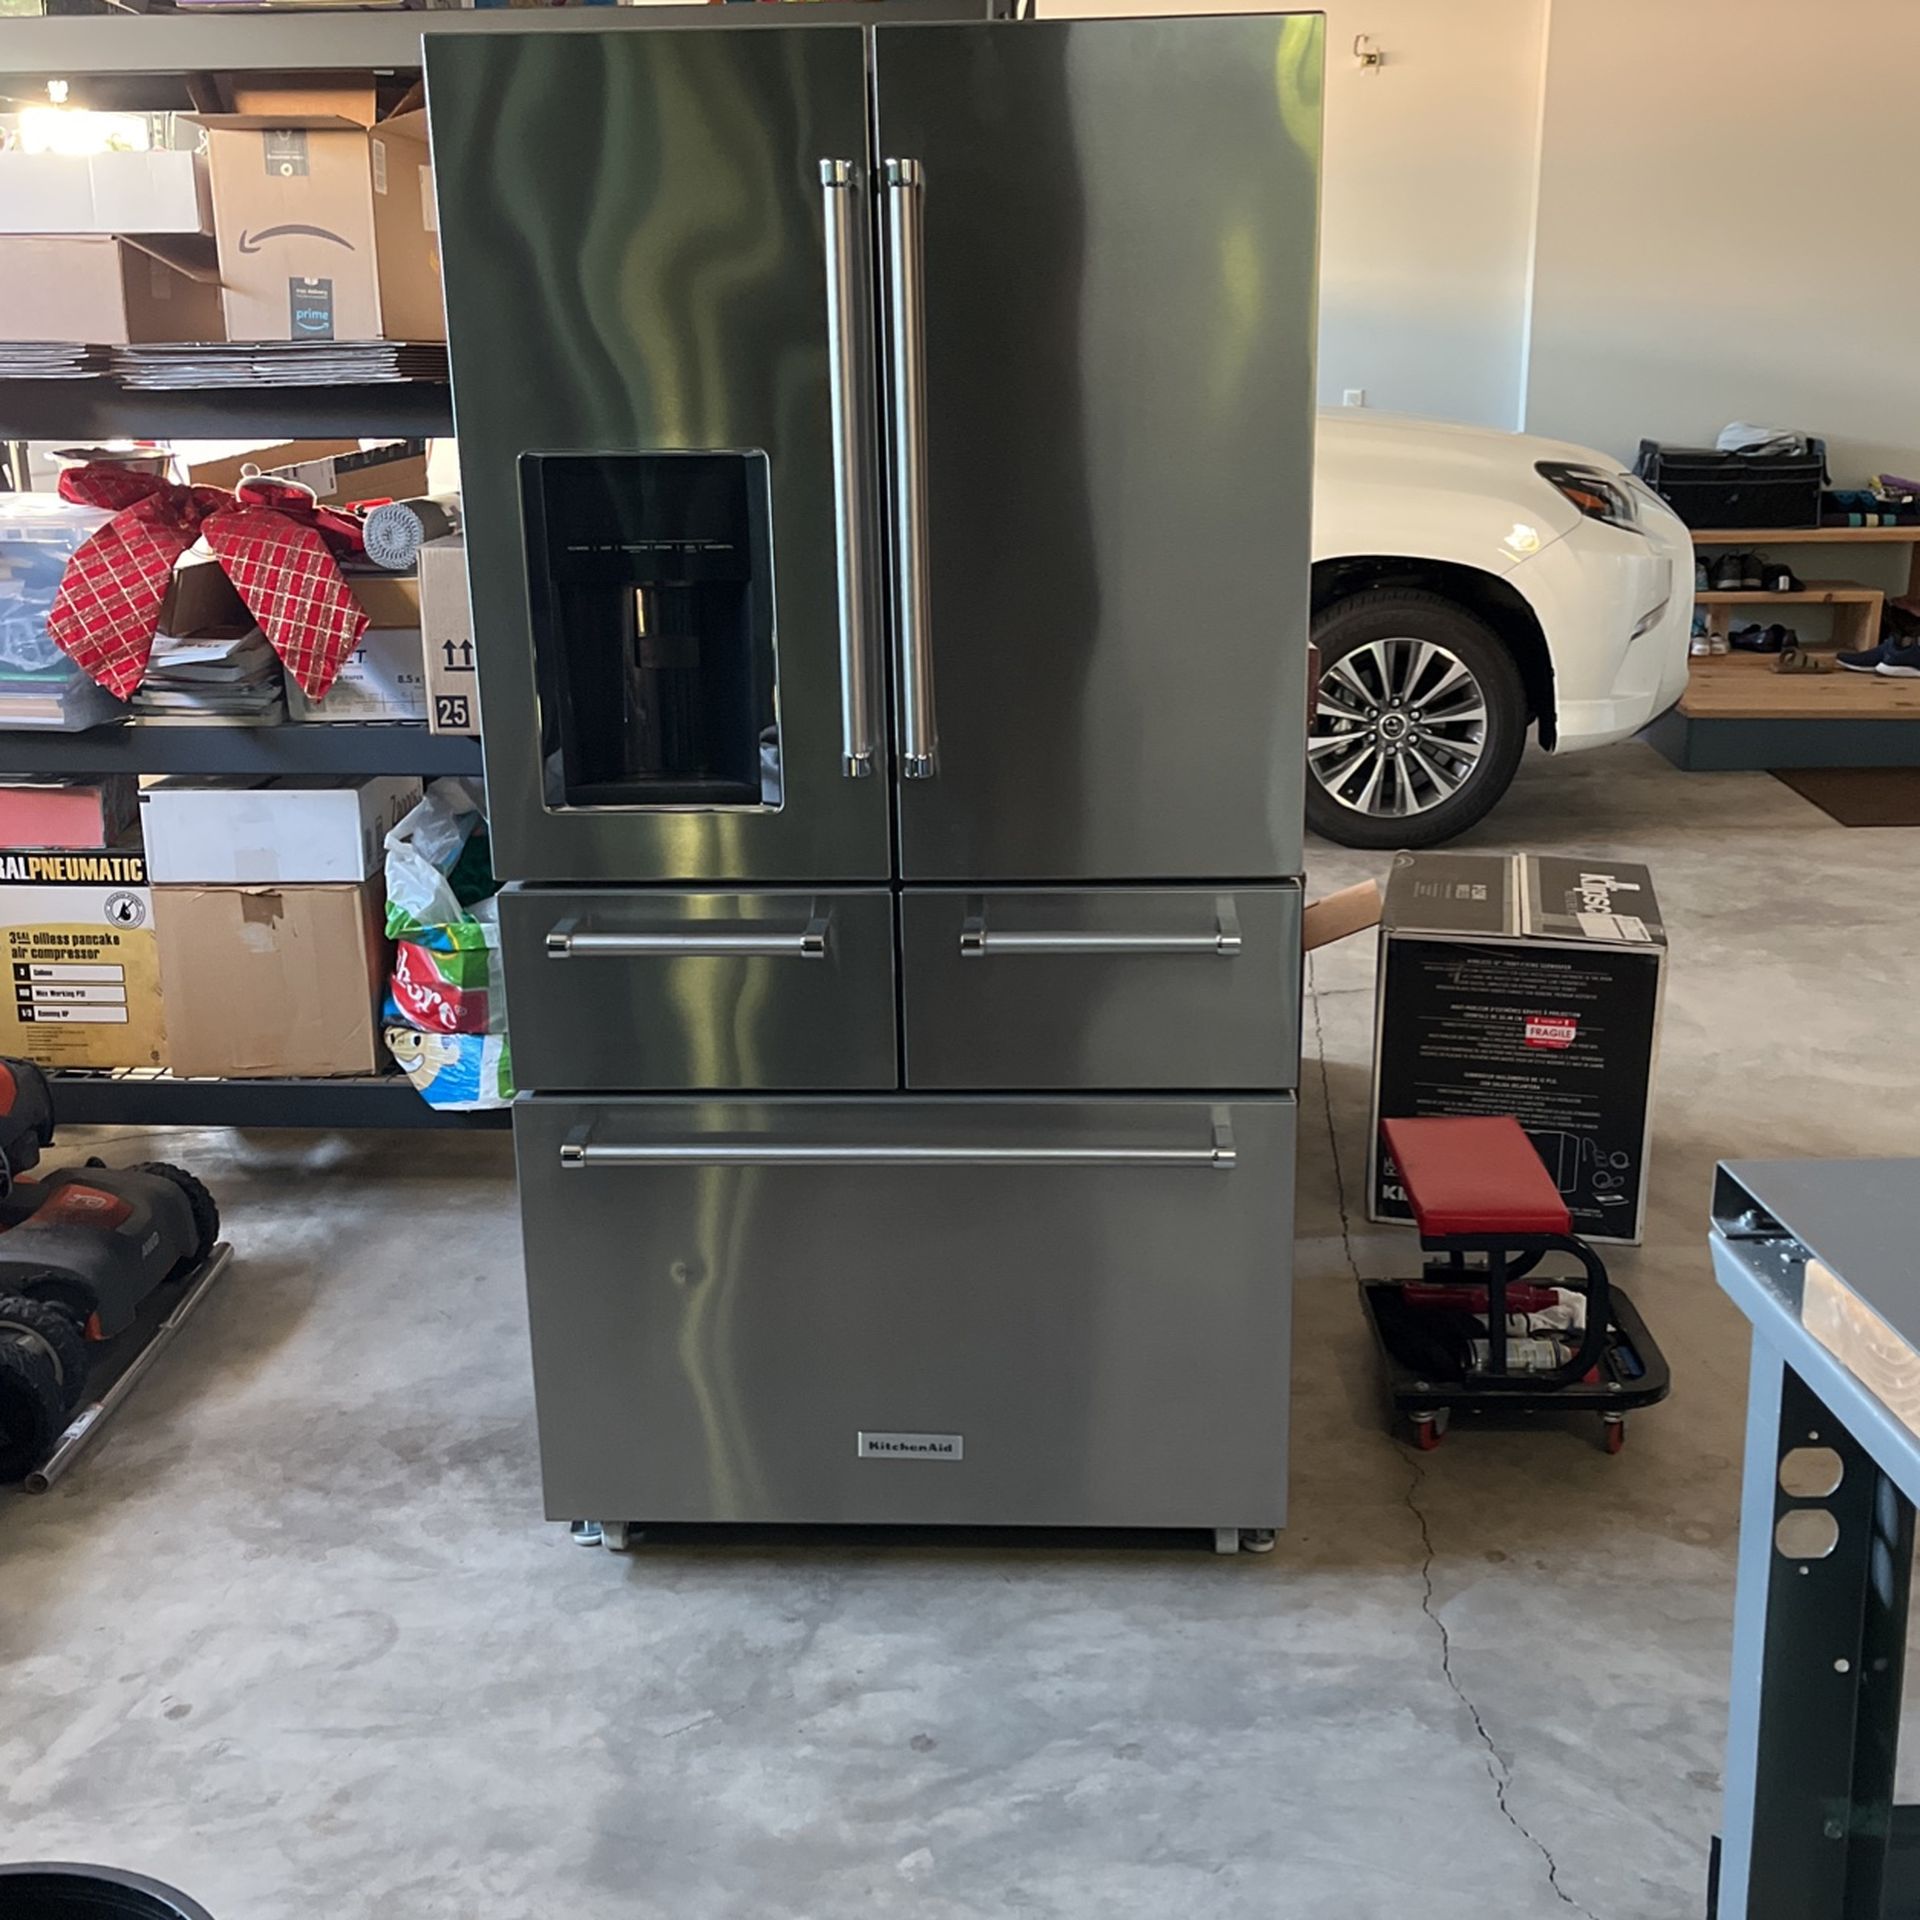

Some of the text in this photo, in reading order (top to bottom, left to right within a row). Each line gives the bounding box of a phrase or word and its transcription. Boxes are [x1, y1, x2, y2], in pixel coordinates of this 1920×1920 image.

[296, 308, 329, 321] prime
[398, 675, 413, 684] 8.5
[439, 699, 467, 725] 25
[33, 932, 70, 946] oilless
[72, 933, 120, 947] pancake
[12, 946, 100, 961] air compressor
[1529, 1026, 1573, 1039] FRAGILE
[868, 1441, 953, 1453] KitchenAid
